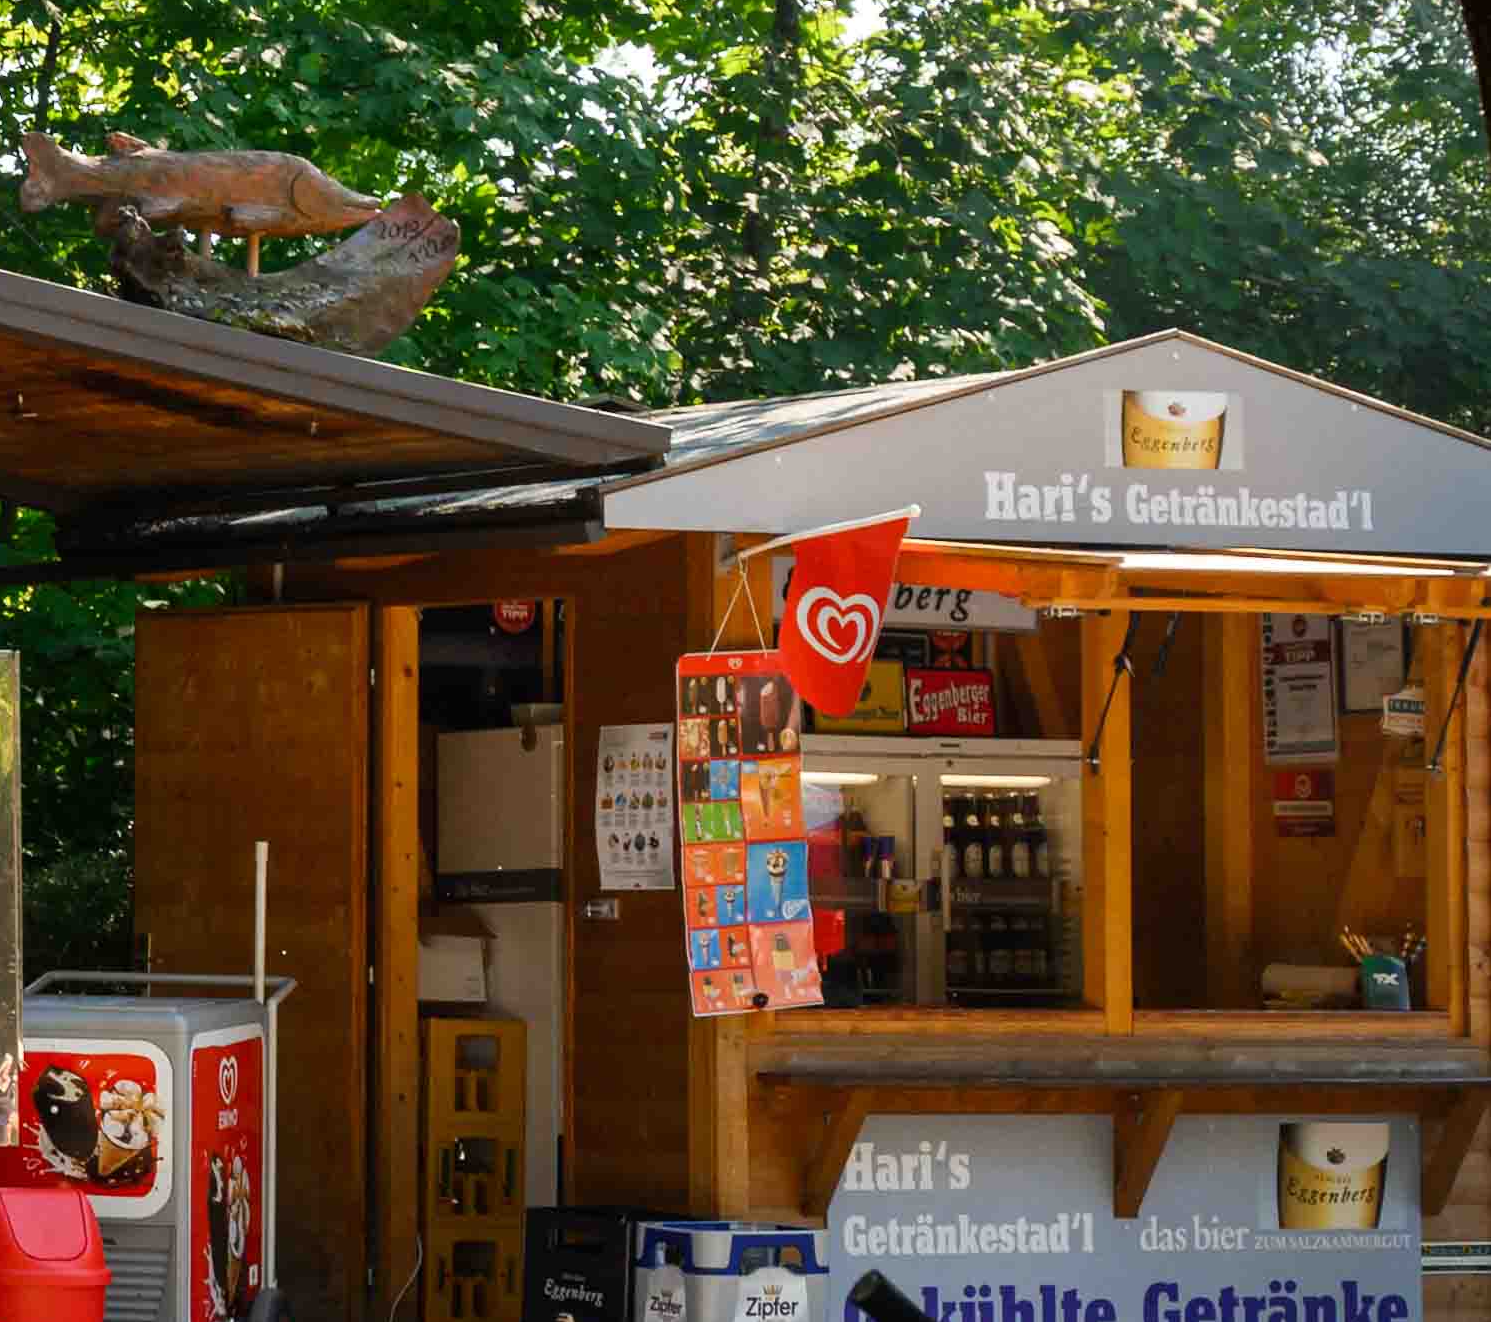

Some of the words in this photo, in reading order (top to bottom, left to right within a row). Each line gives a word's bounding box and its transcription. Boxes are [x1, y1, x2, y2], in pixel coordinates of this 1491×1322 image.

[1130, 425, 1215, 453] Eggenberg
[910, 678, 991, 723] Eggenberger
[958, 704, 988, 725] Bier
[1287, 1177, 1375, 1205] Eggenberg
[1140, 1216, 1188, 1252] das
[1193, 1215, 1250, 1250] bier
[543, 1278, 604, 1307] Eggenberg
[649, 1296, 682, 1315] Zipfer
[745, 1297, 799, 1320] Zipfer
